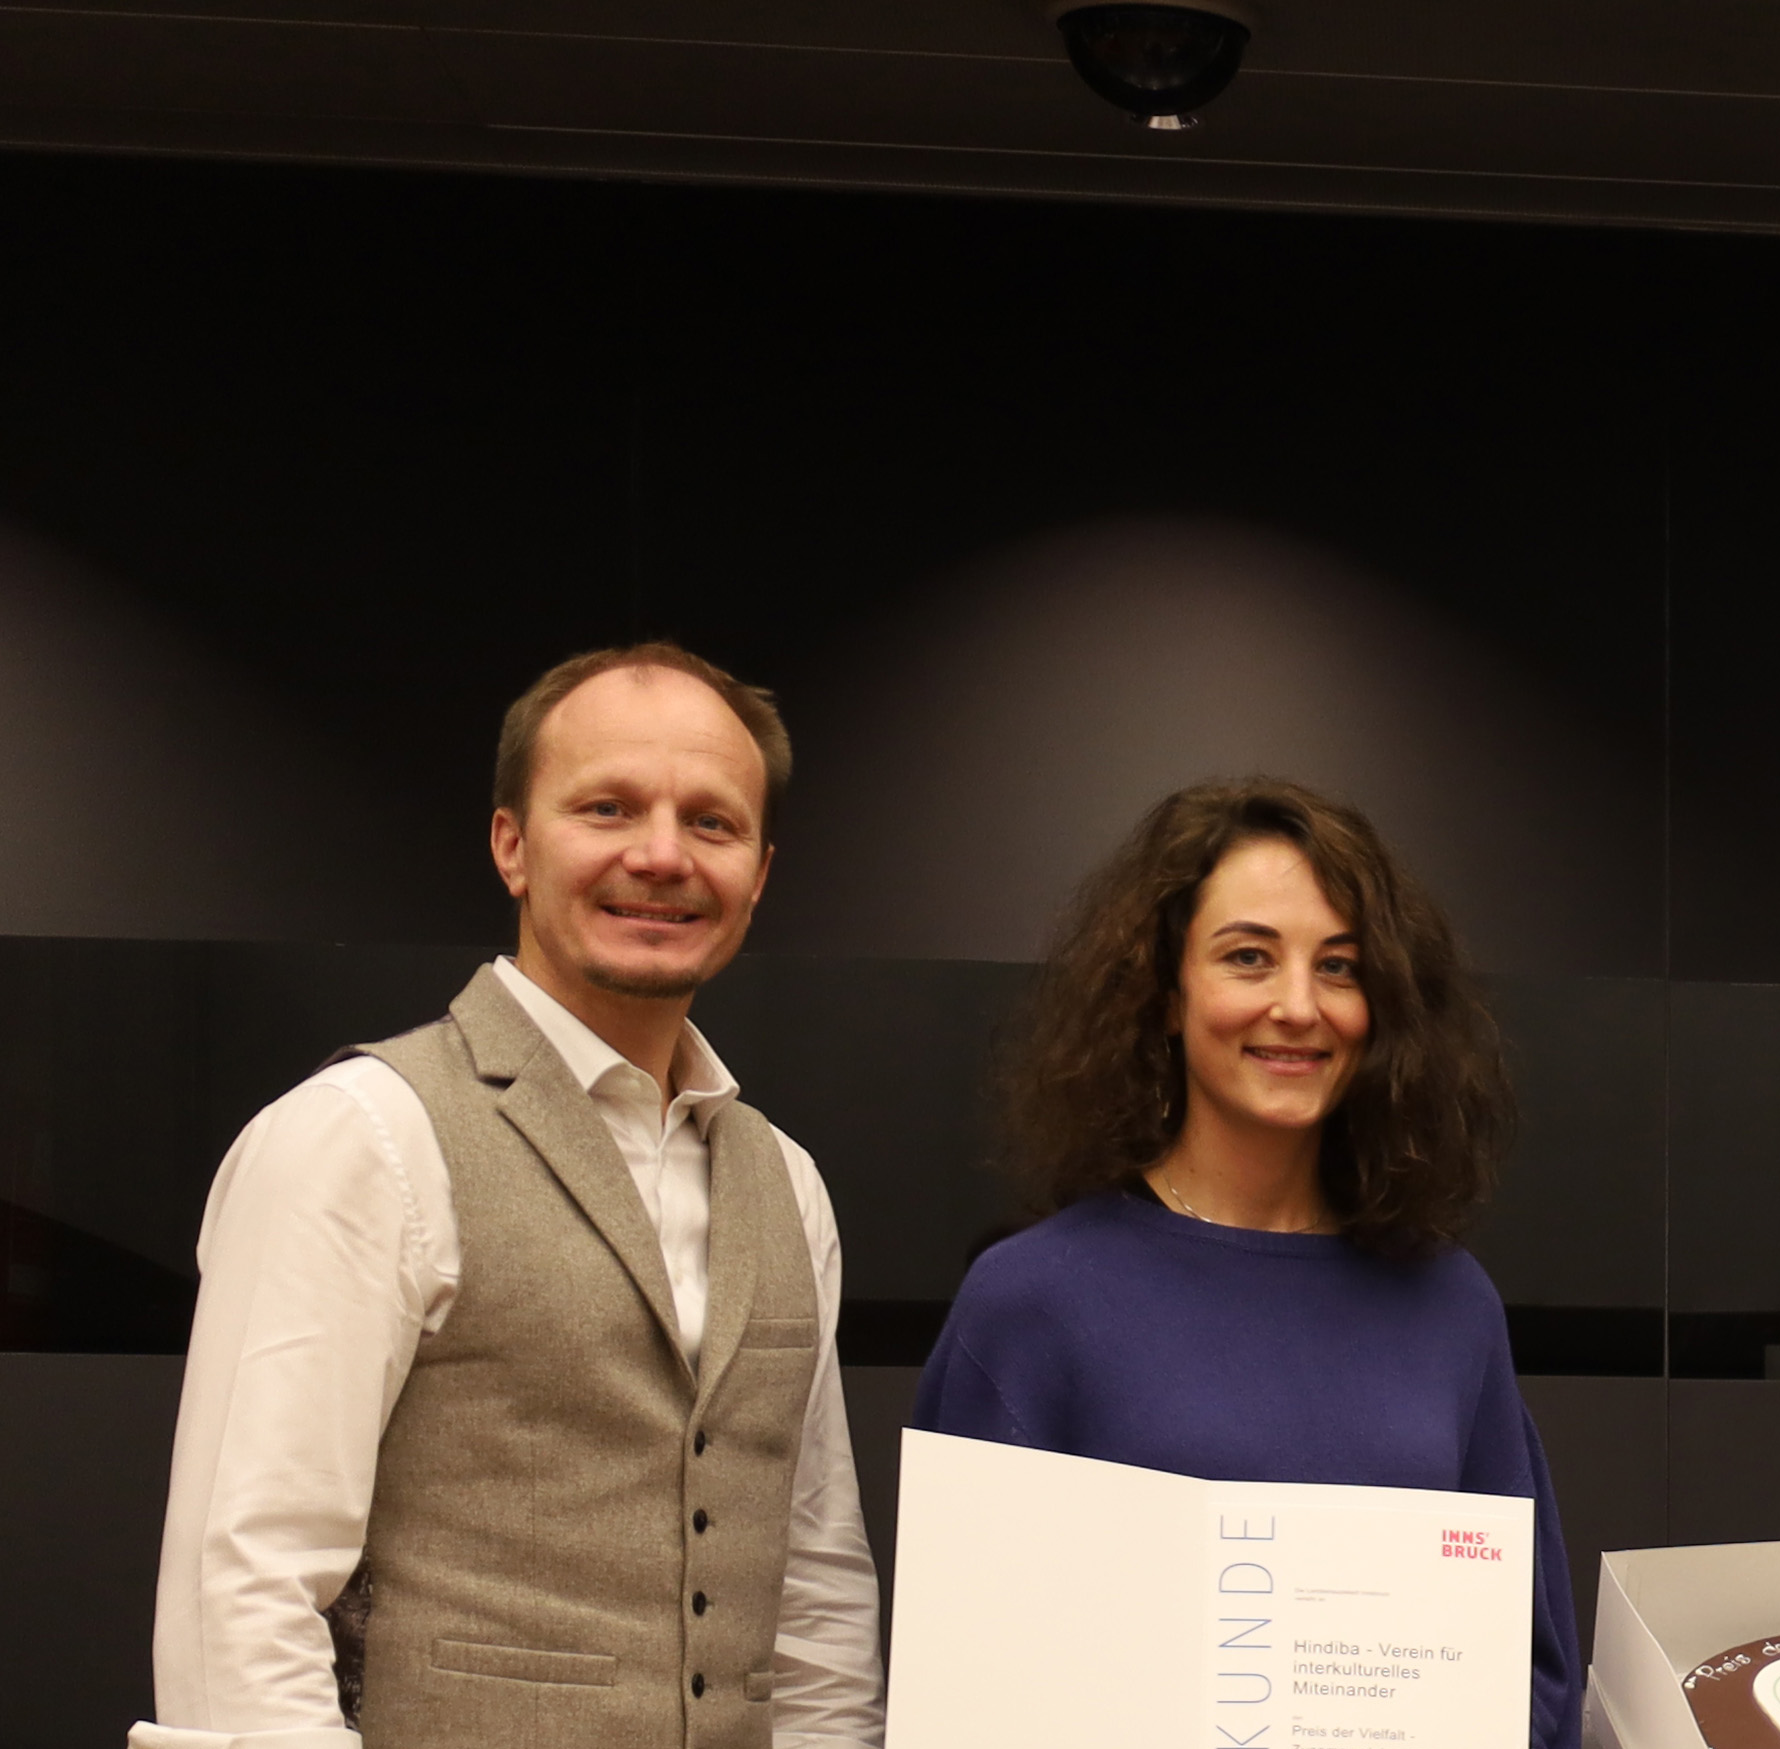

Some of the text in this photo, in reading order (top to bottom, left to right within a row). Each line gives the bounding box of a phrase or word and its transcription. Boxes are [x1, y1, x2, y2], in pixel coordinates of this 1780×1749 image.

[1442, 1544, 1502, 1561] BRUCK
[1378, 1642, 1434, 1659] Verein
[1440, 1646, 1463, 1661] für
[1293, 1660, 1421, 1679] interkulturelles
[1696, 1654, 1751, 1681] Preis
[1292, 1681, 1396, 1698] Miteinander
[1291, 1725, 1327, 1737] Preis
[1332, 1726, 1354, 1738] der
[1358, 1728, 1405, 1741] Vielfalt
